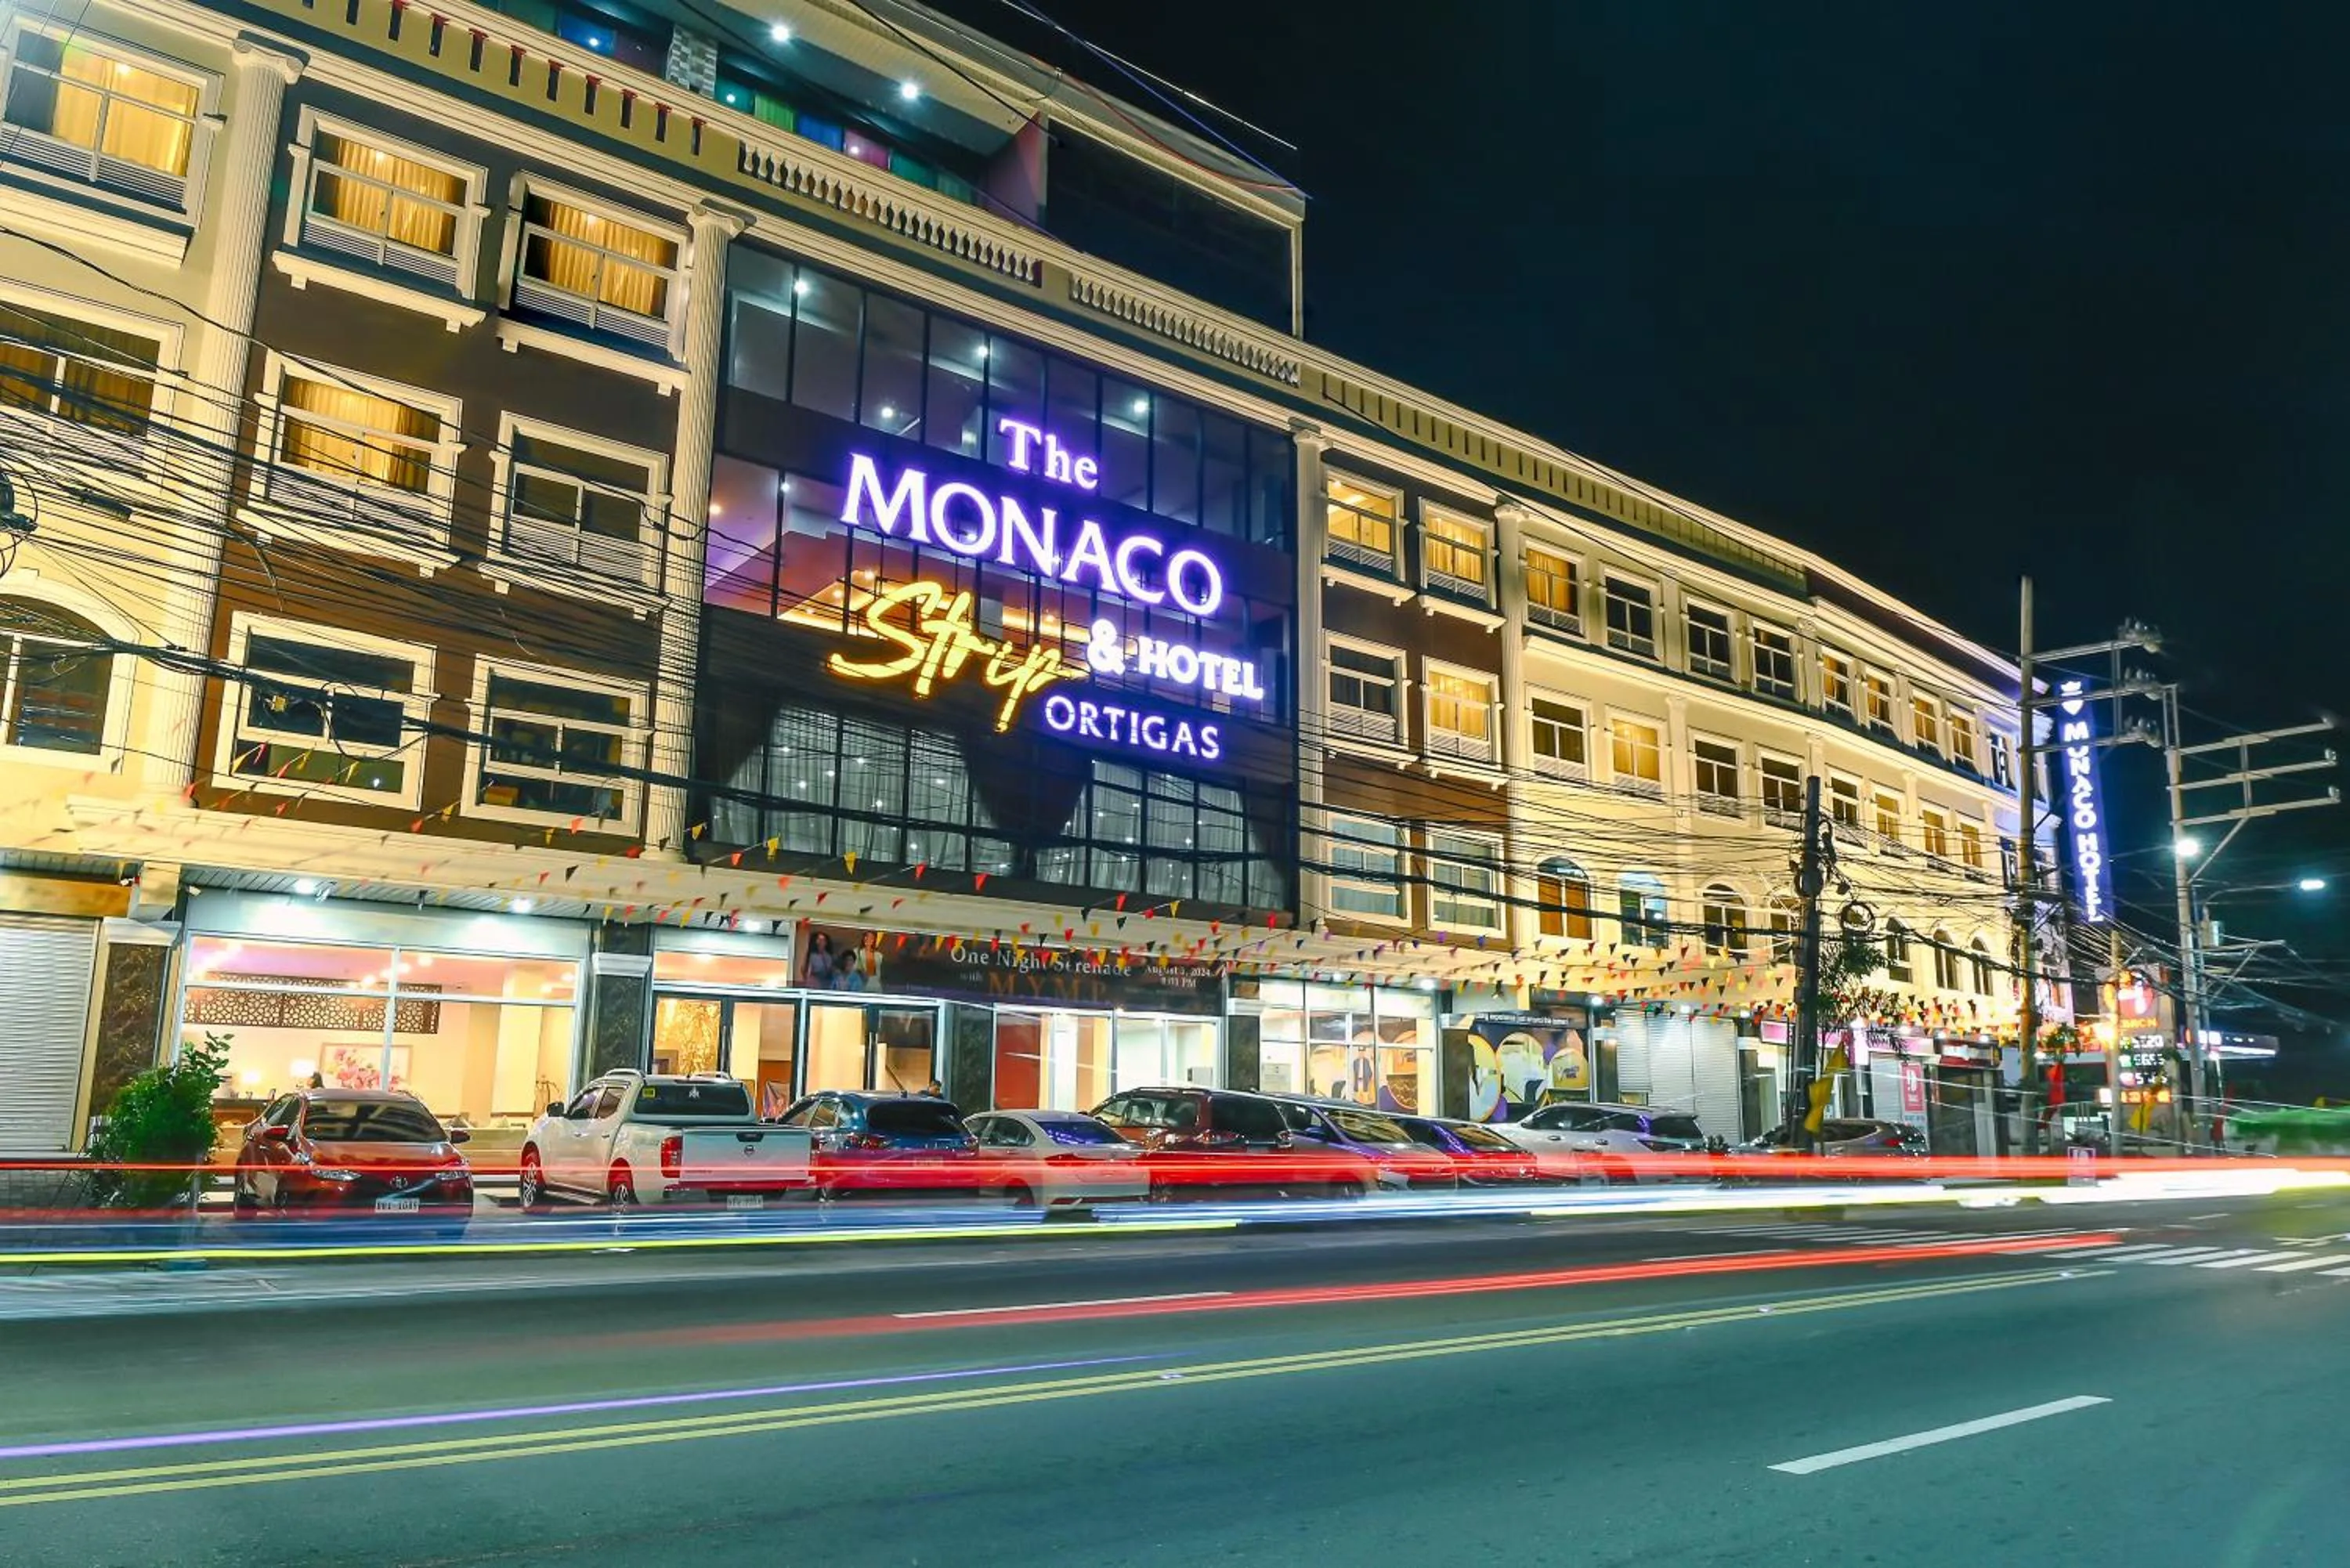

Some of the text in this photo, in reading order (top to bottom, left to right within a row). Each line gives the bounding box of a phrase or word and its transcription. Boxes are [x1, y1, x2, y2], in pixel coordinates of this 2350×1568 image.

[999, 417, 1098, 490] The
[840, 453, 1224, 616] MONACO
[828, 581, 1264, 733] Strip & HOTEL
[1045, 695, 1220, 760] ORTIGAS
[2064, 721, 2103, 923] MONACO HOTEL
[950, 945, 990, 965] One
